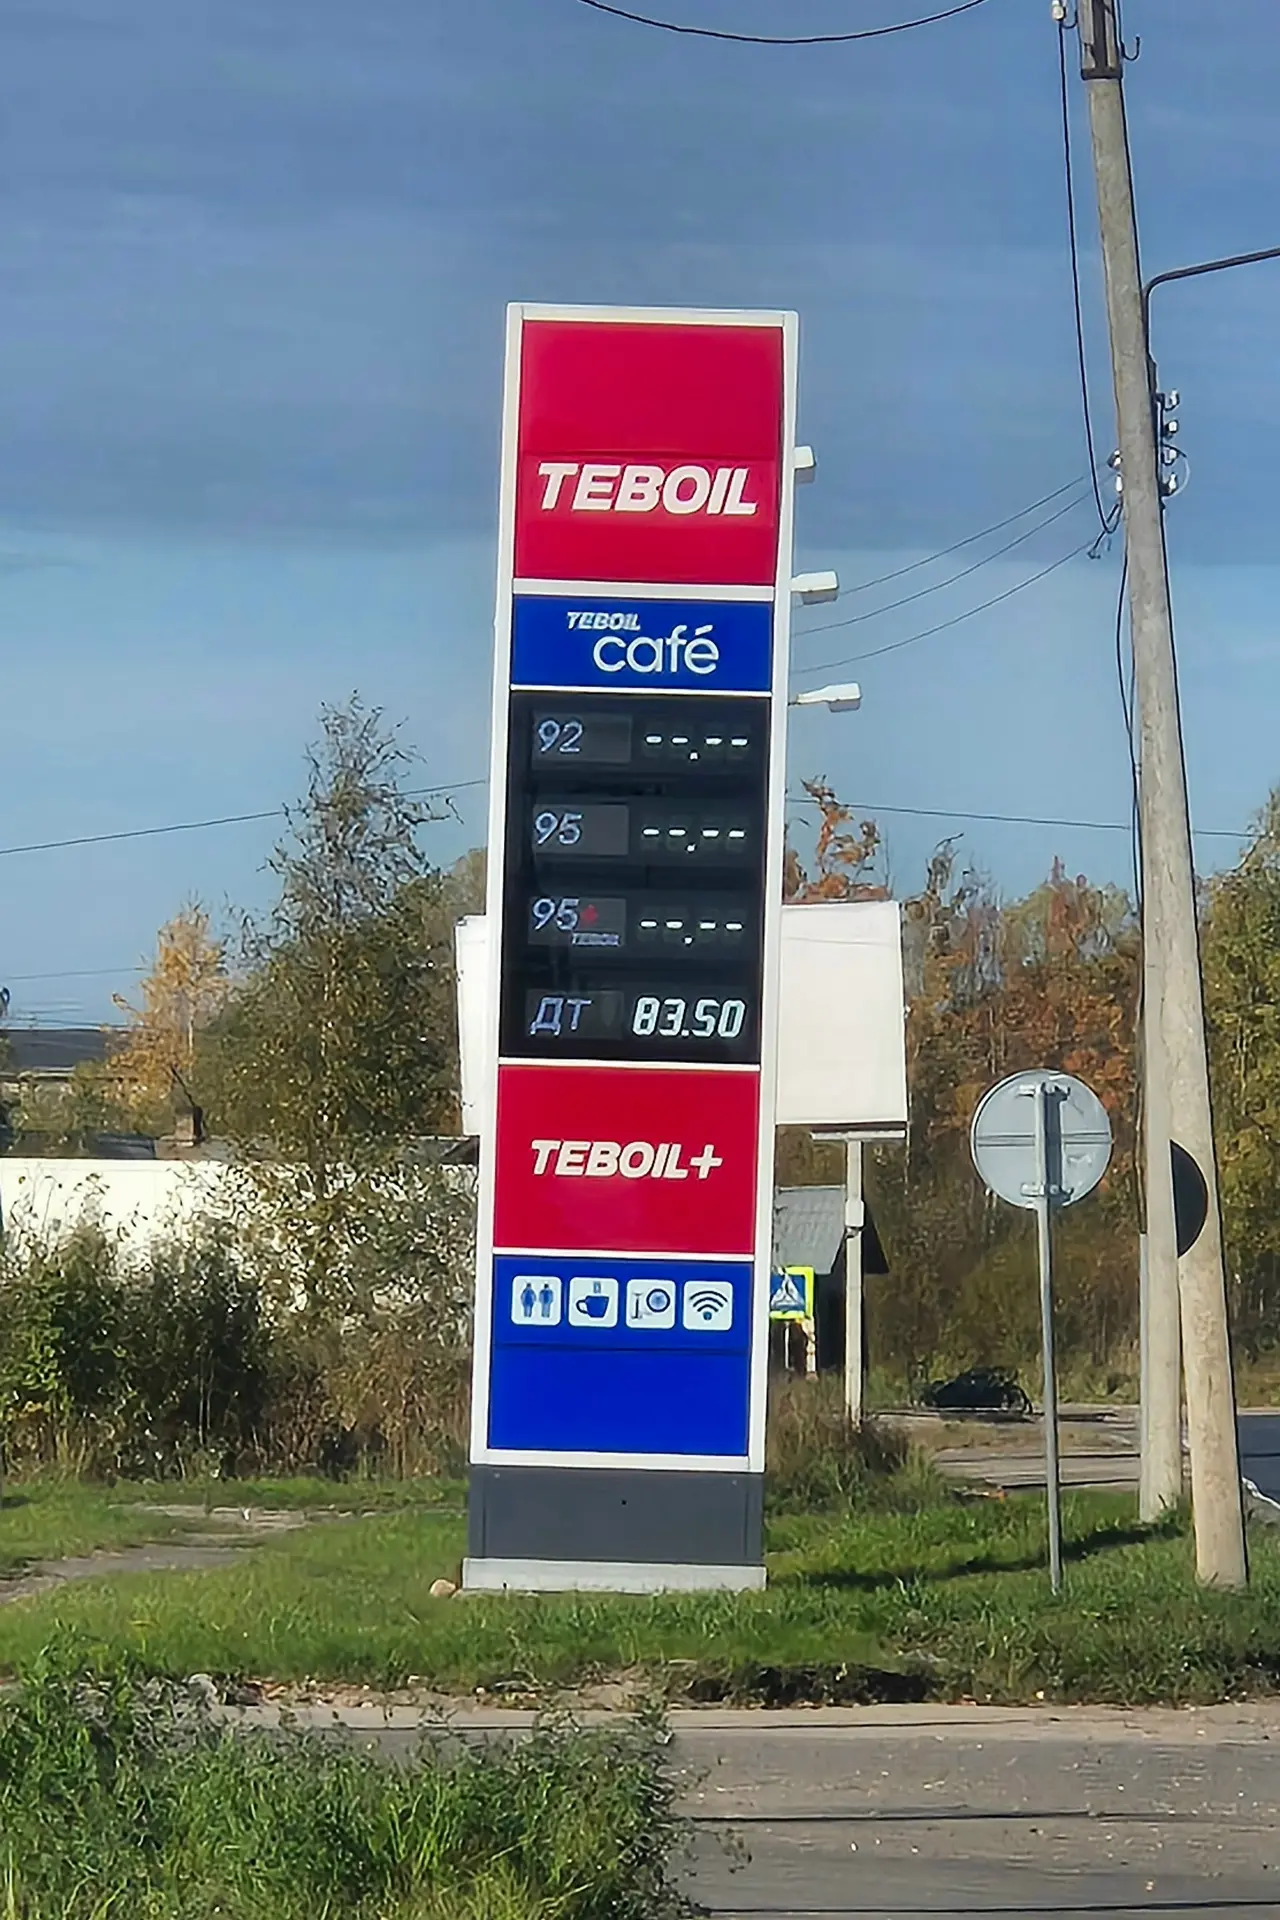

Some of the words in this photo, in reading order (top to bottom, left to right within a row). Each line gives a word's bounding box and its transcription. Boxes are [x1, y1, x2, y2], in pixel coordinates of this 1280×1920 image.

[538, 462, 758, 515] TEBOIL
[567, 611, 641, 631] TEBOIL
[593, 624, 719, 674] café
[537, 719, 584, 753] 92
[534, 811, 583, 845] 95
[529, 996, 592, 1036] ДТ
[632, 996, 746, 1038] 83.50
